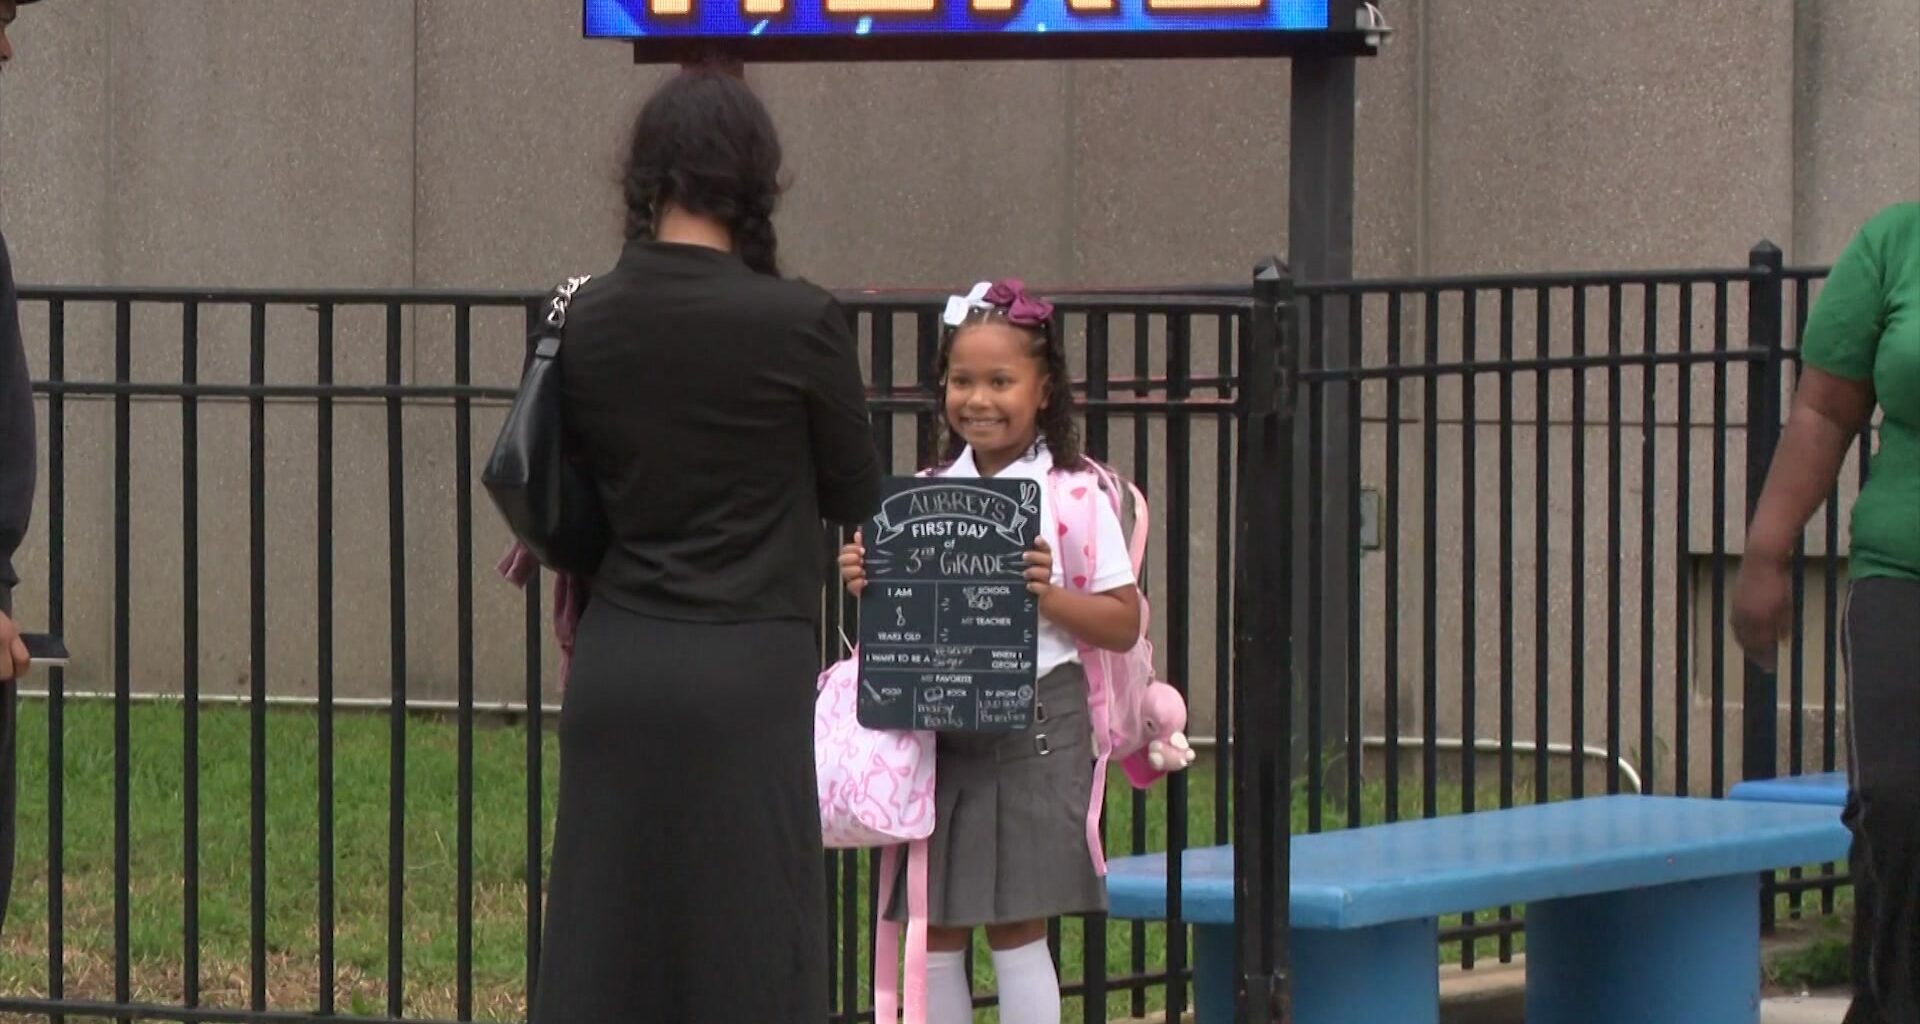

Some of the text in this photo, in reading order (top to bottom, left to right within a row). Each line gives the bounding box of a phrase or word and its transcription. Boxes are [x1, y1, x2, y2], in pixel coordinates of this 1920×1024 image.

[909, 492, 1006, 522] AUBREY'S
[911, 522, 989, 539] FIRST DAY
[943, 537, 956, 549] of
[940, 551, 1005, 576] GRADE
[887, 587, 912, 597] I AM
[978, 586, 1010, 595] SCHOOL
[976, 617, 1011, 626] TEACHER
[878, 632, 921, 641] YEARS OLD
[865, 653, 931, 662] I WANT TO BE A
[992, 650, 1023, 659] WHEN I
[992, 660, 1032, 669] GROW UP
[935, 674, 973, 684] FAVORITE
[881, 687, 902, 696] FOOD
[946, 688, 967, 697] BOOK
